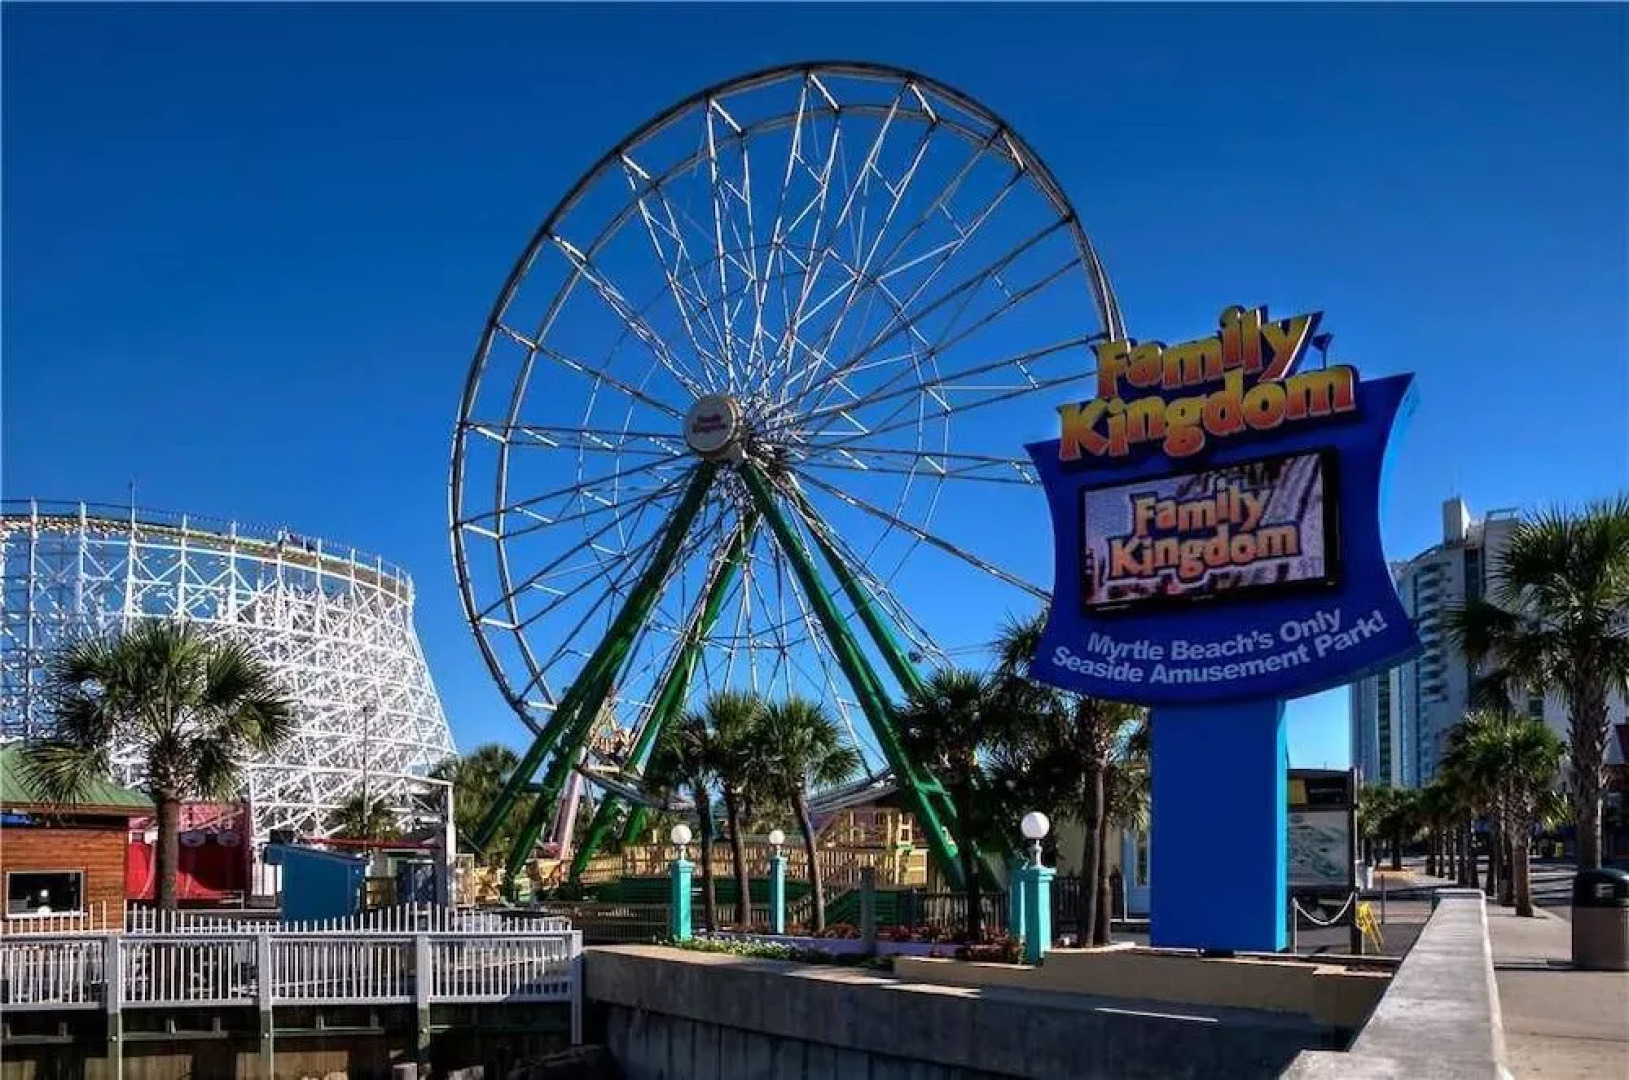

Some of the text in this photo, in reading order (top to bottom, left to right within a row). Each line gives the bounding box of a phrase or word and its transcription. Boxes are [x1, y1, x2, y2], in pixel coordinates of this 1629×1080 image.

[1097, 306, 1313, 398] Family
[1058, 365, 1357, 460] Kingdom
[1132, 477, 1271, 536] Family
[1111, 522, 1298, 579] Kingdom
[1052, 610, 1388, 684] Seaside Amusement Park!
[1087, 608, 1341, 664] Myrtle Beach's Only
